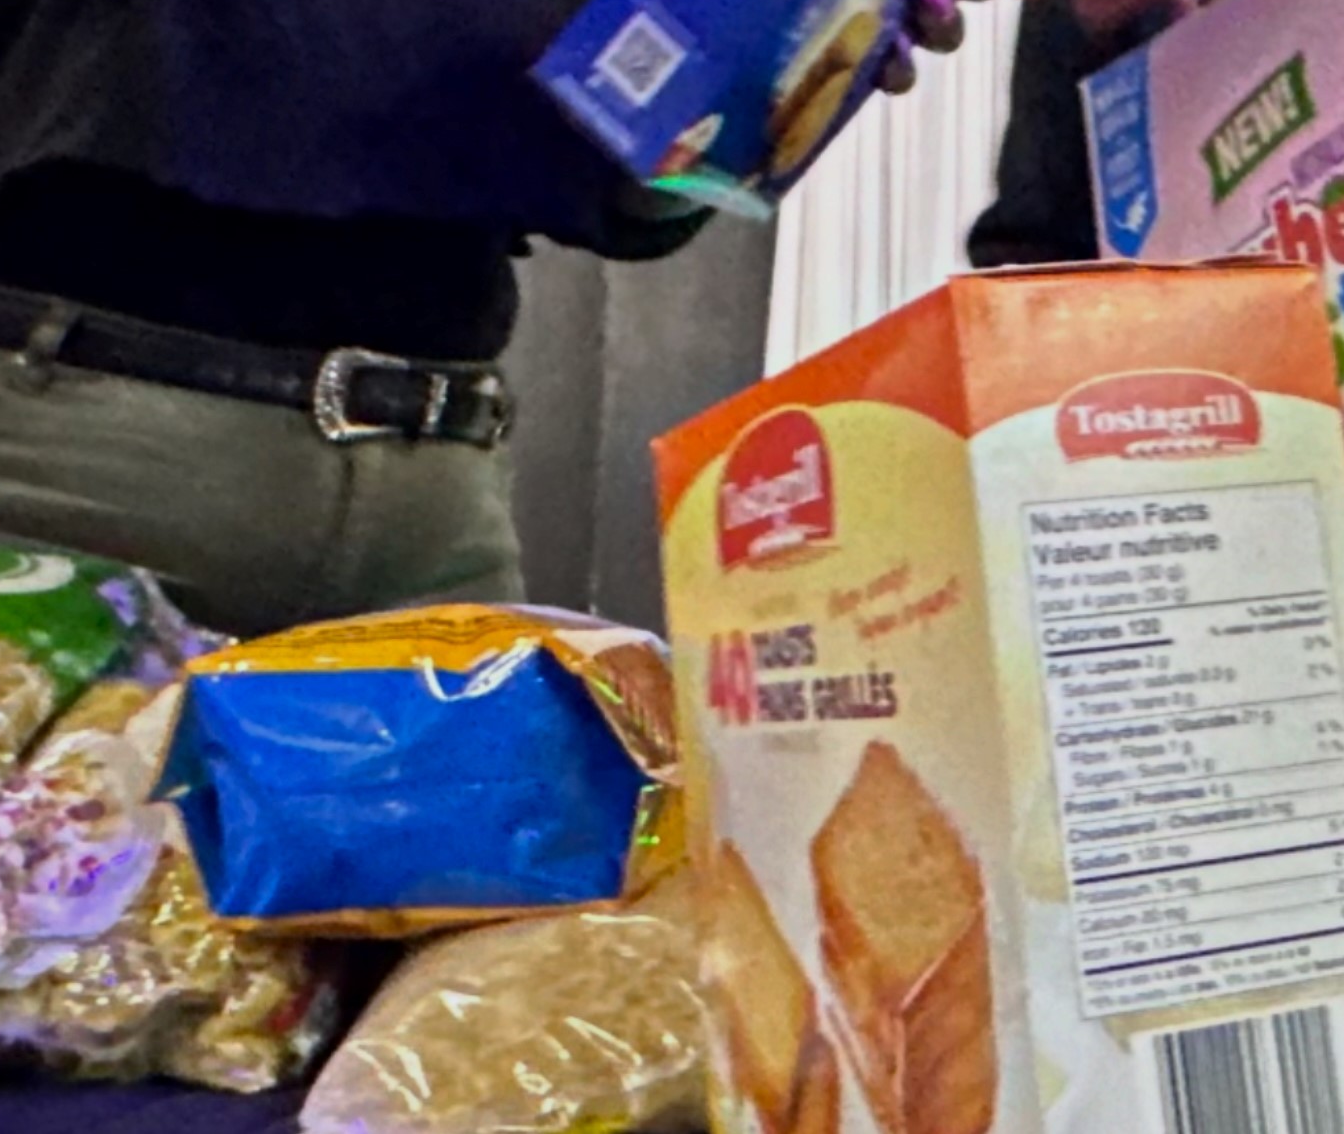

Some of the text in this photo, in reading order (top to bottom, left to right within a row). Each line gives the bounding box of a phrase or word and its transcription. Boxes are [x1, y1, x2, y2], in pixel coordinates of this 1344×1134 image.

[1212, 70, 1301, 183] NEW!
[1068, 394, 1243, 437] Tostagrill
[1030, 502, 1211, 535] Nutrition Facts
[1033, 531, 1221, 566] Valeur nutritive
[1043, 623, 1124, 647] Calories
